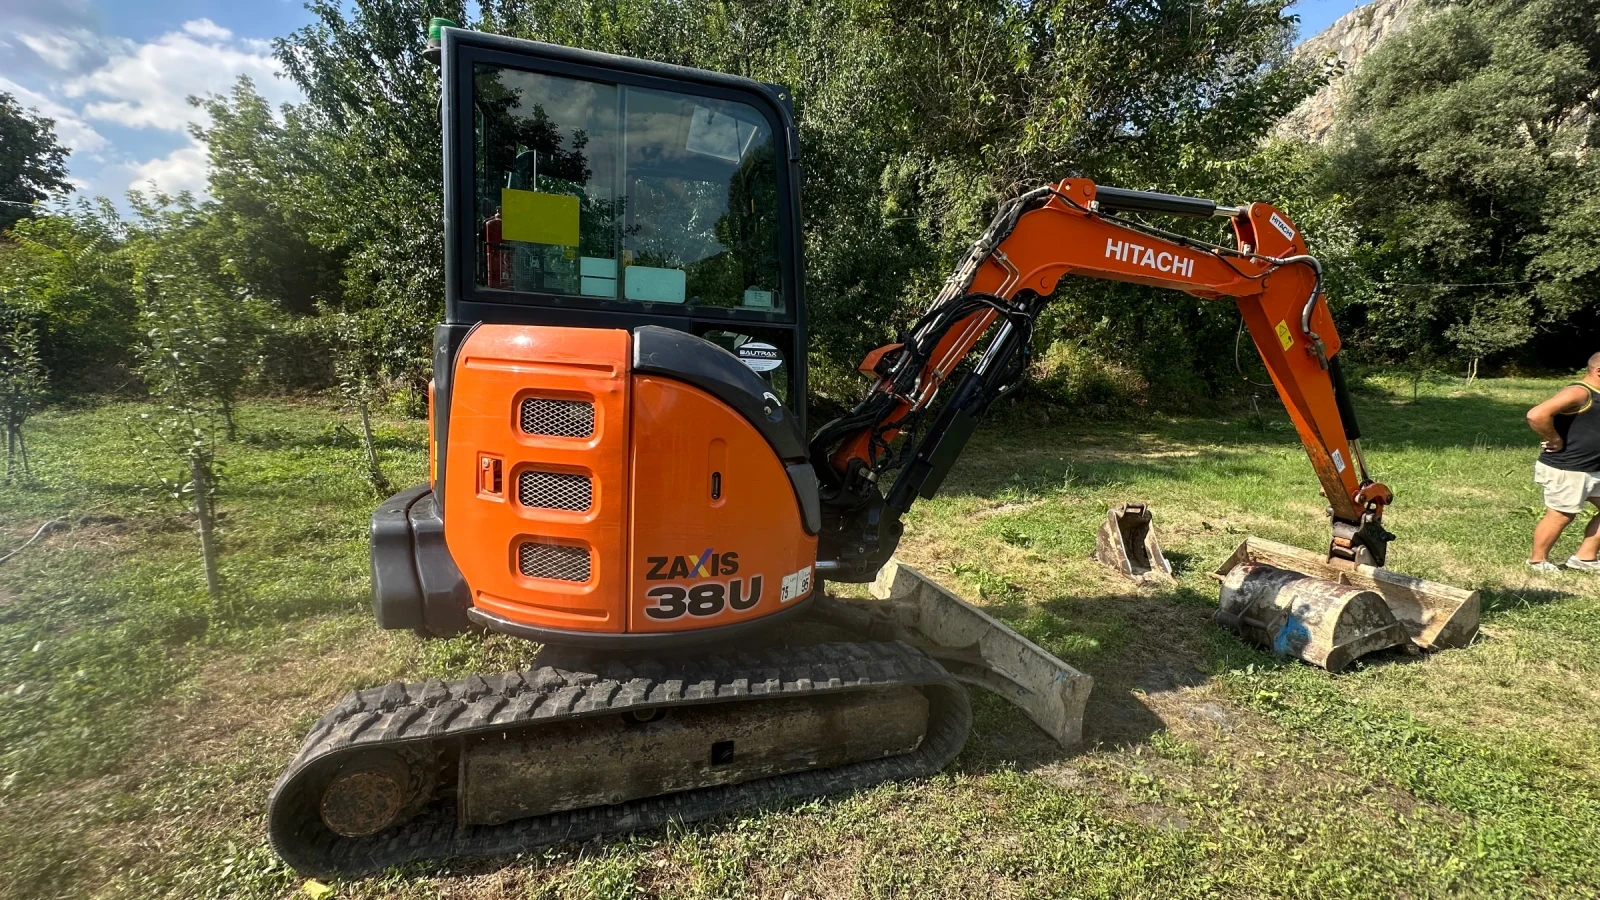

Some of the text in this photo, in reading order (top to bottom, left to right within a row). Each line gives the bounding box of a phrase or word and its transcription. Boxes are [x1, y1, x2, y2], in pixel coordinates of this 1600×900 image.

[1271, 215, 1293, 238] HITACHI
[1105, 238, 1194, 278] HITACHI
[646, 548, 739, 580] ZAXIS
[645, 575, 762, 619] 38U
[781, 586, 789, 601] 75
[801, 577, 810, 593] 95
